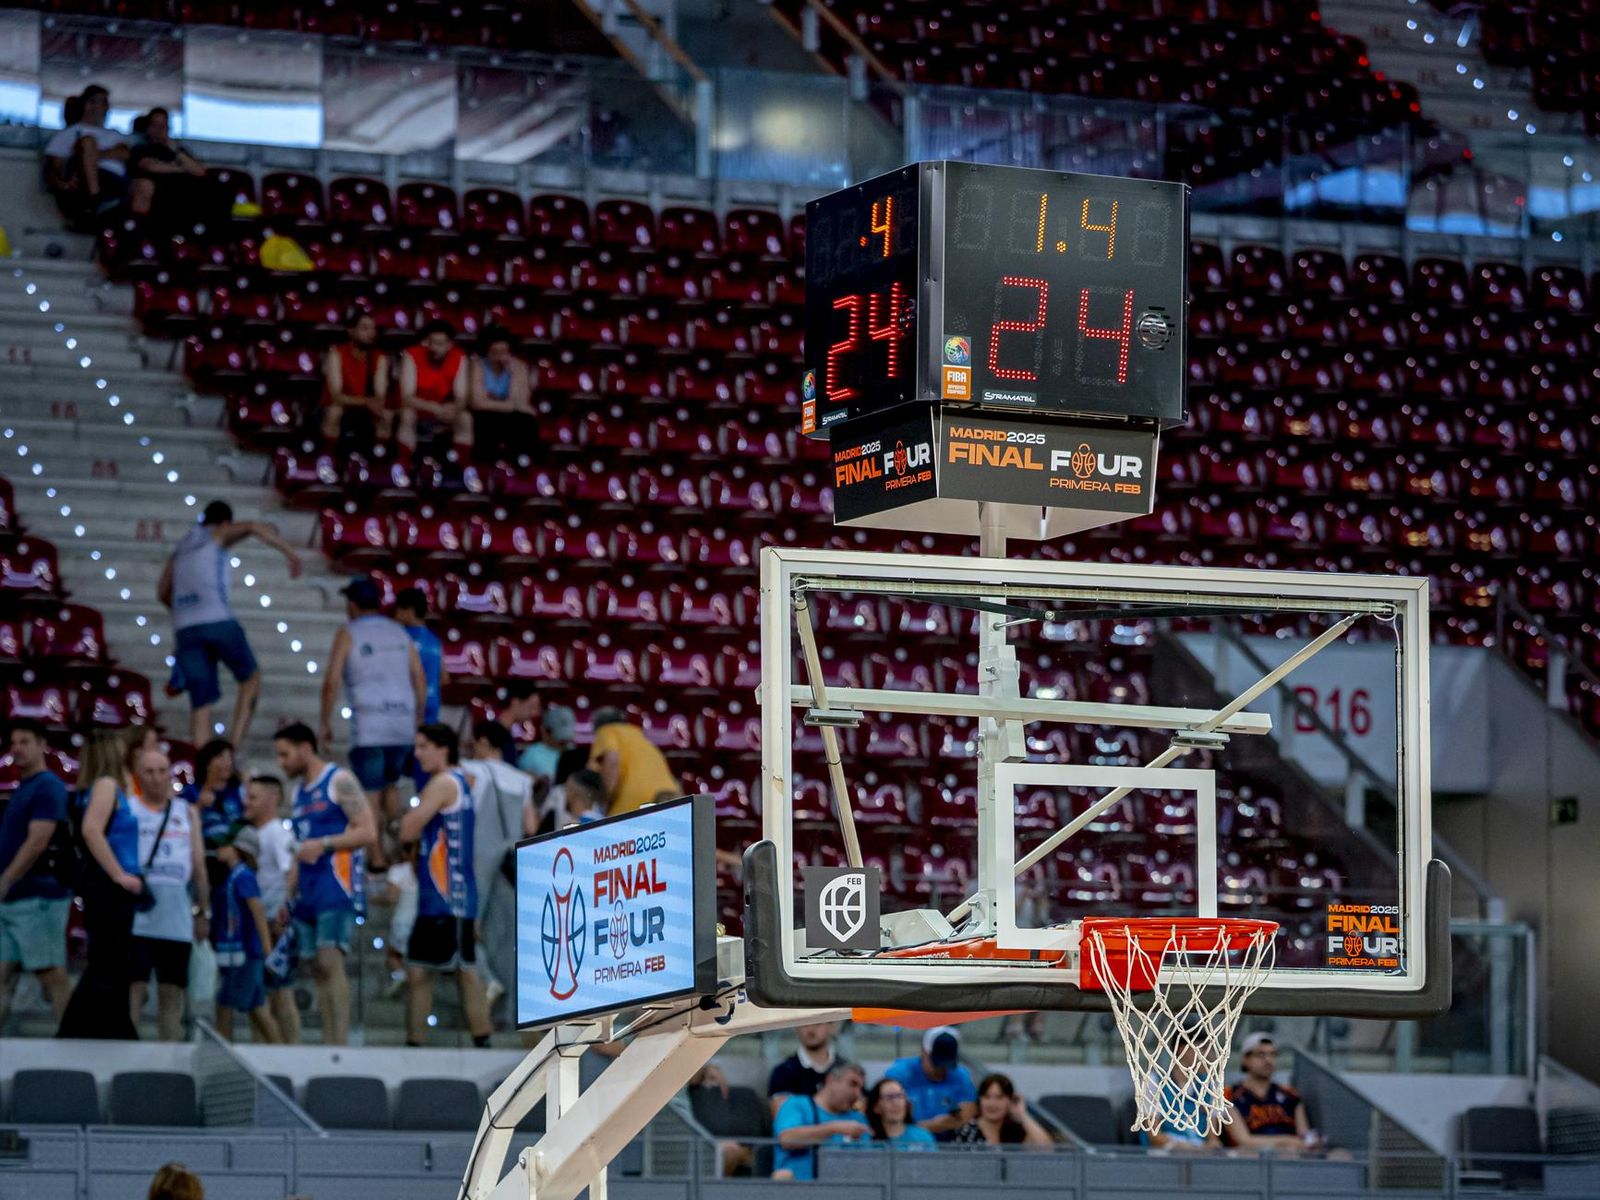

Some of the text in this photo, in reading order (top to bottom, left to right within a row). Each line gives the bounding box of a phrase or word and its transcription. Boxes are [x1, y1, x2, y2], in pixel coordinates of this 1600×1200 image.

[1036, 192, 1119, 260] 1.4
[825, 281, 902, 401] 24
[988, 275, 1135, 385] 24
[947, 371, 967, 383] FIBA
[950, 426, 1046, 445] MADRID2025
[834, 440, 881, 464] MADRID2025
[948, 442, 1044, 471] FINAL
[835, 456, 882, 489] FINAL
[885, 470, 933, 492] PRIMERA FEB
[1050, 478, 1142, 495] PRIMERA FEB
[1293, 685, 1372, 736] B16
[593, 831, 667, 865] MADRID2025
[593, 858, 667, 908] FINAL
[846, 877, 862, 886] FEB
[1327, 904, 1399, 914] MADRID2025
[1327, 914, 1401, 933] FINAL
[594, 954, 666, 985] PRIMERA FEB
[1328, 957, 1398, 967] PRIMERA FEB
